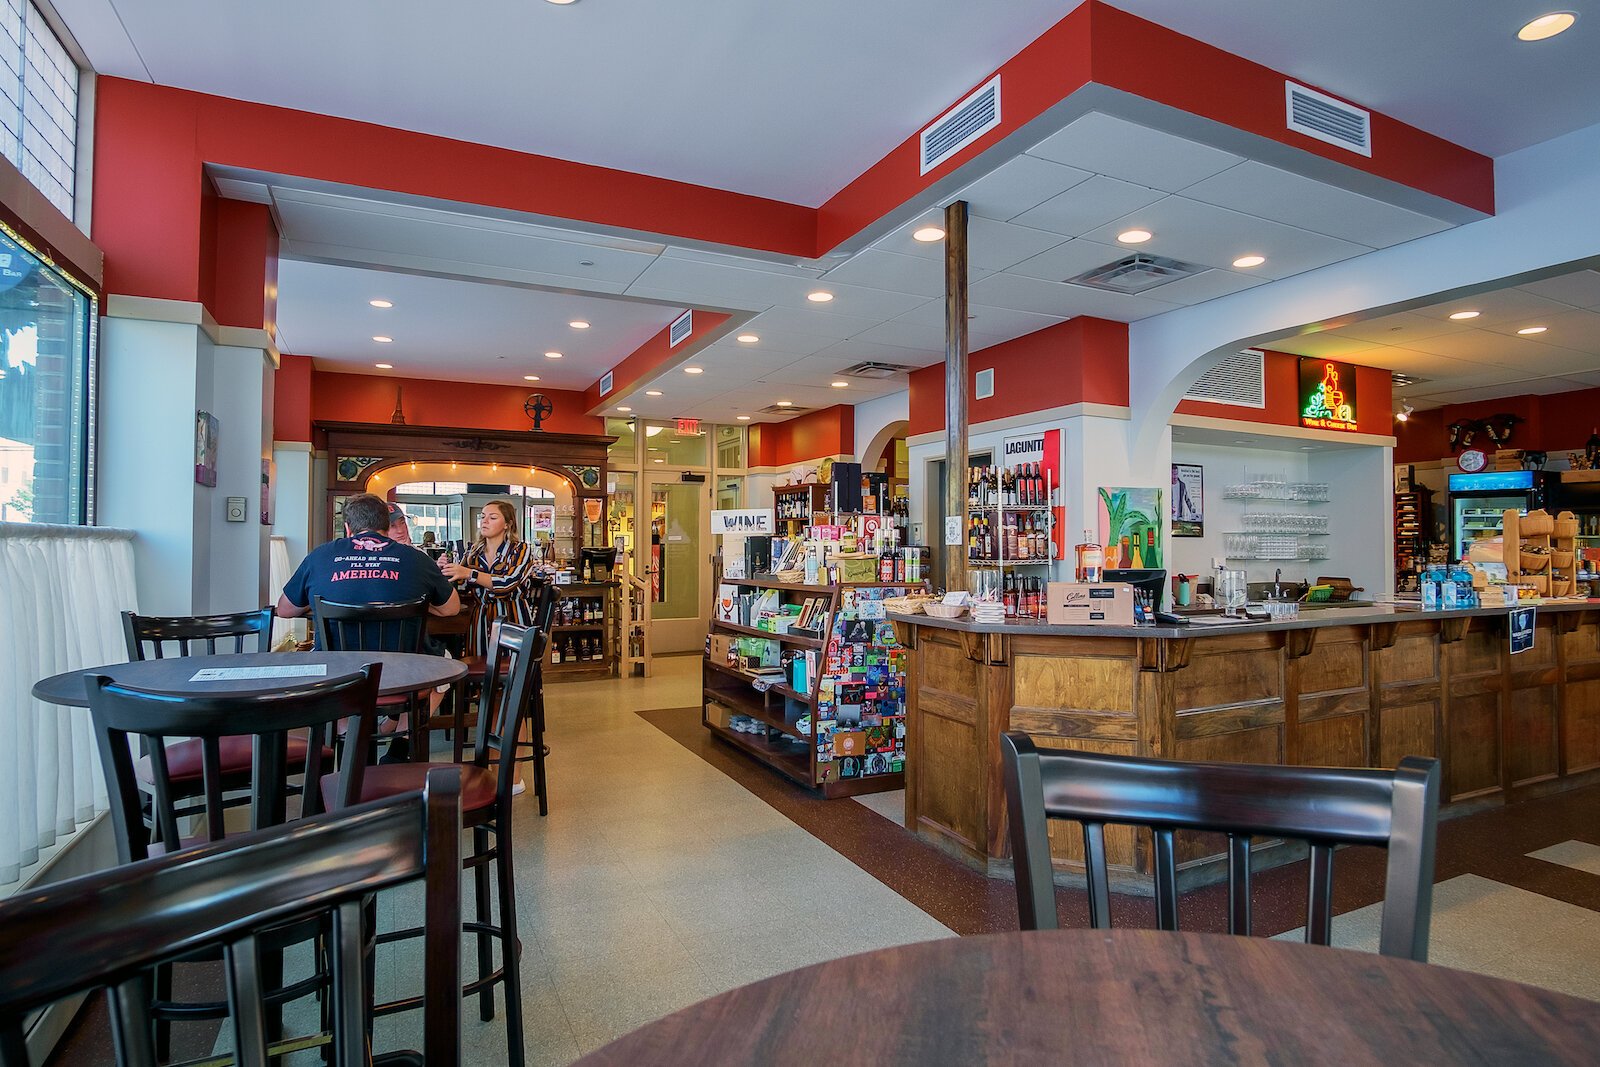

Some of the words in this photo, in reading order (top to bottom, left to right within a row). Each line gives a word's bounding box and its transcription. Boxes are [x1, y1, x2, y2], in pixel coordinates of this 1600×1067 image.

[677, 419, 698, 433] EXIT
[1006, 439, 1044, 455] LAGUNIT
[723, 515, 767, 531] WINE
[331, 569, 400, 582] AMERICAN
